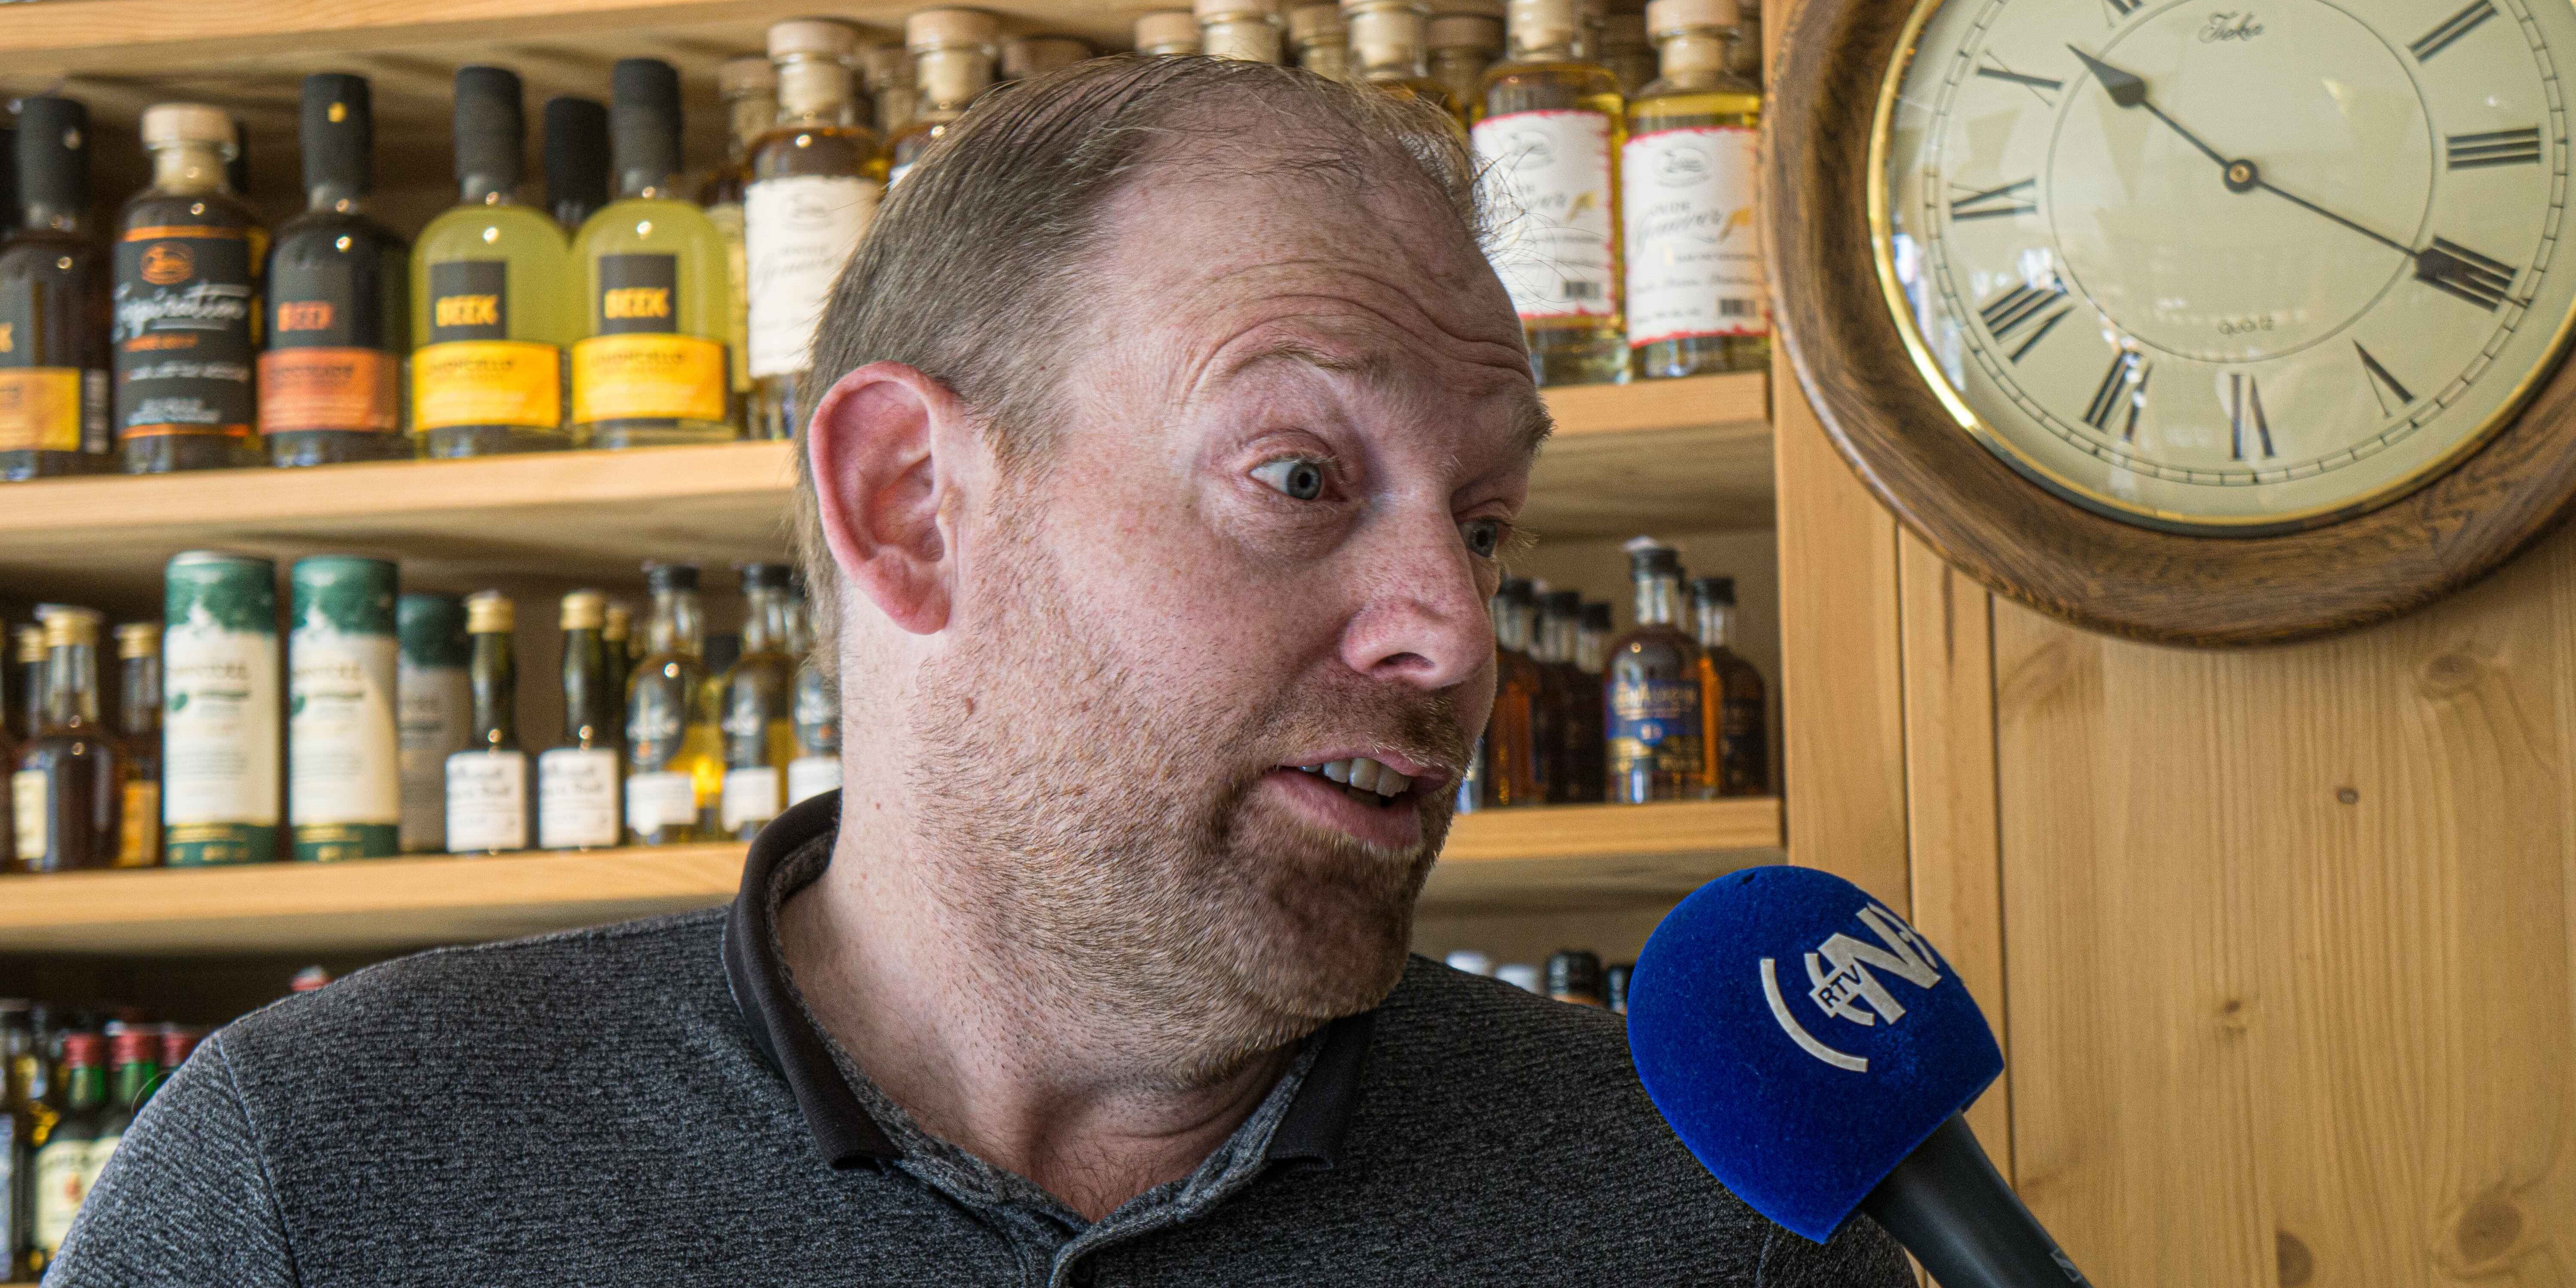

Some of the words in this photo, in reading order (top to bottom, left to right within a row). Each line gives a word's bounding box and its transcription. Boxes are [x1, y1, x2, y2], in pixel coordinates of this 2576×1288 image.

[2447, 127, 2541, 170] III
[1948, 177, 2037, 222] IX
[435, 294, 499, 327] BEEK
[604, 286, 670, 319] BEEK
[2352, 338, 2414, 418] V
[1818, 964, 1862, 1009] RTV
